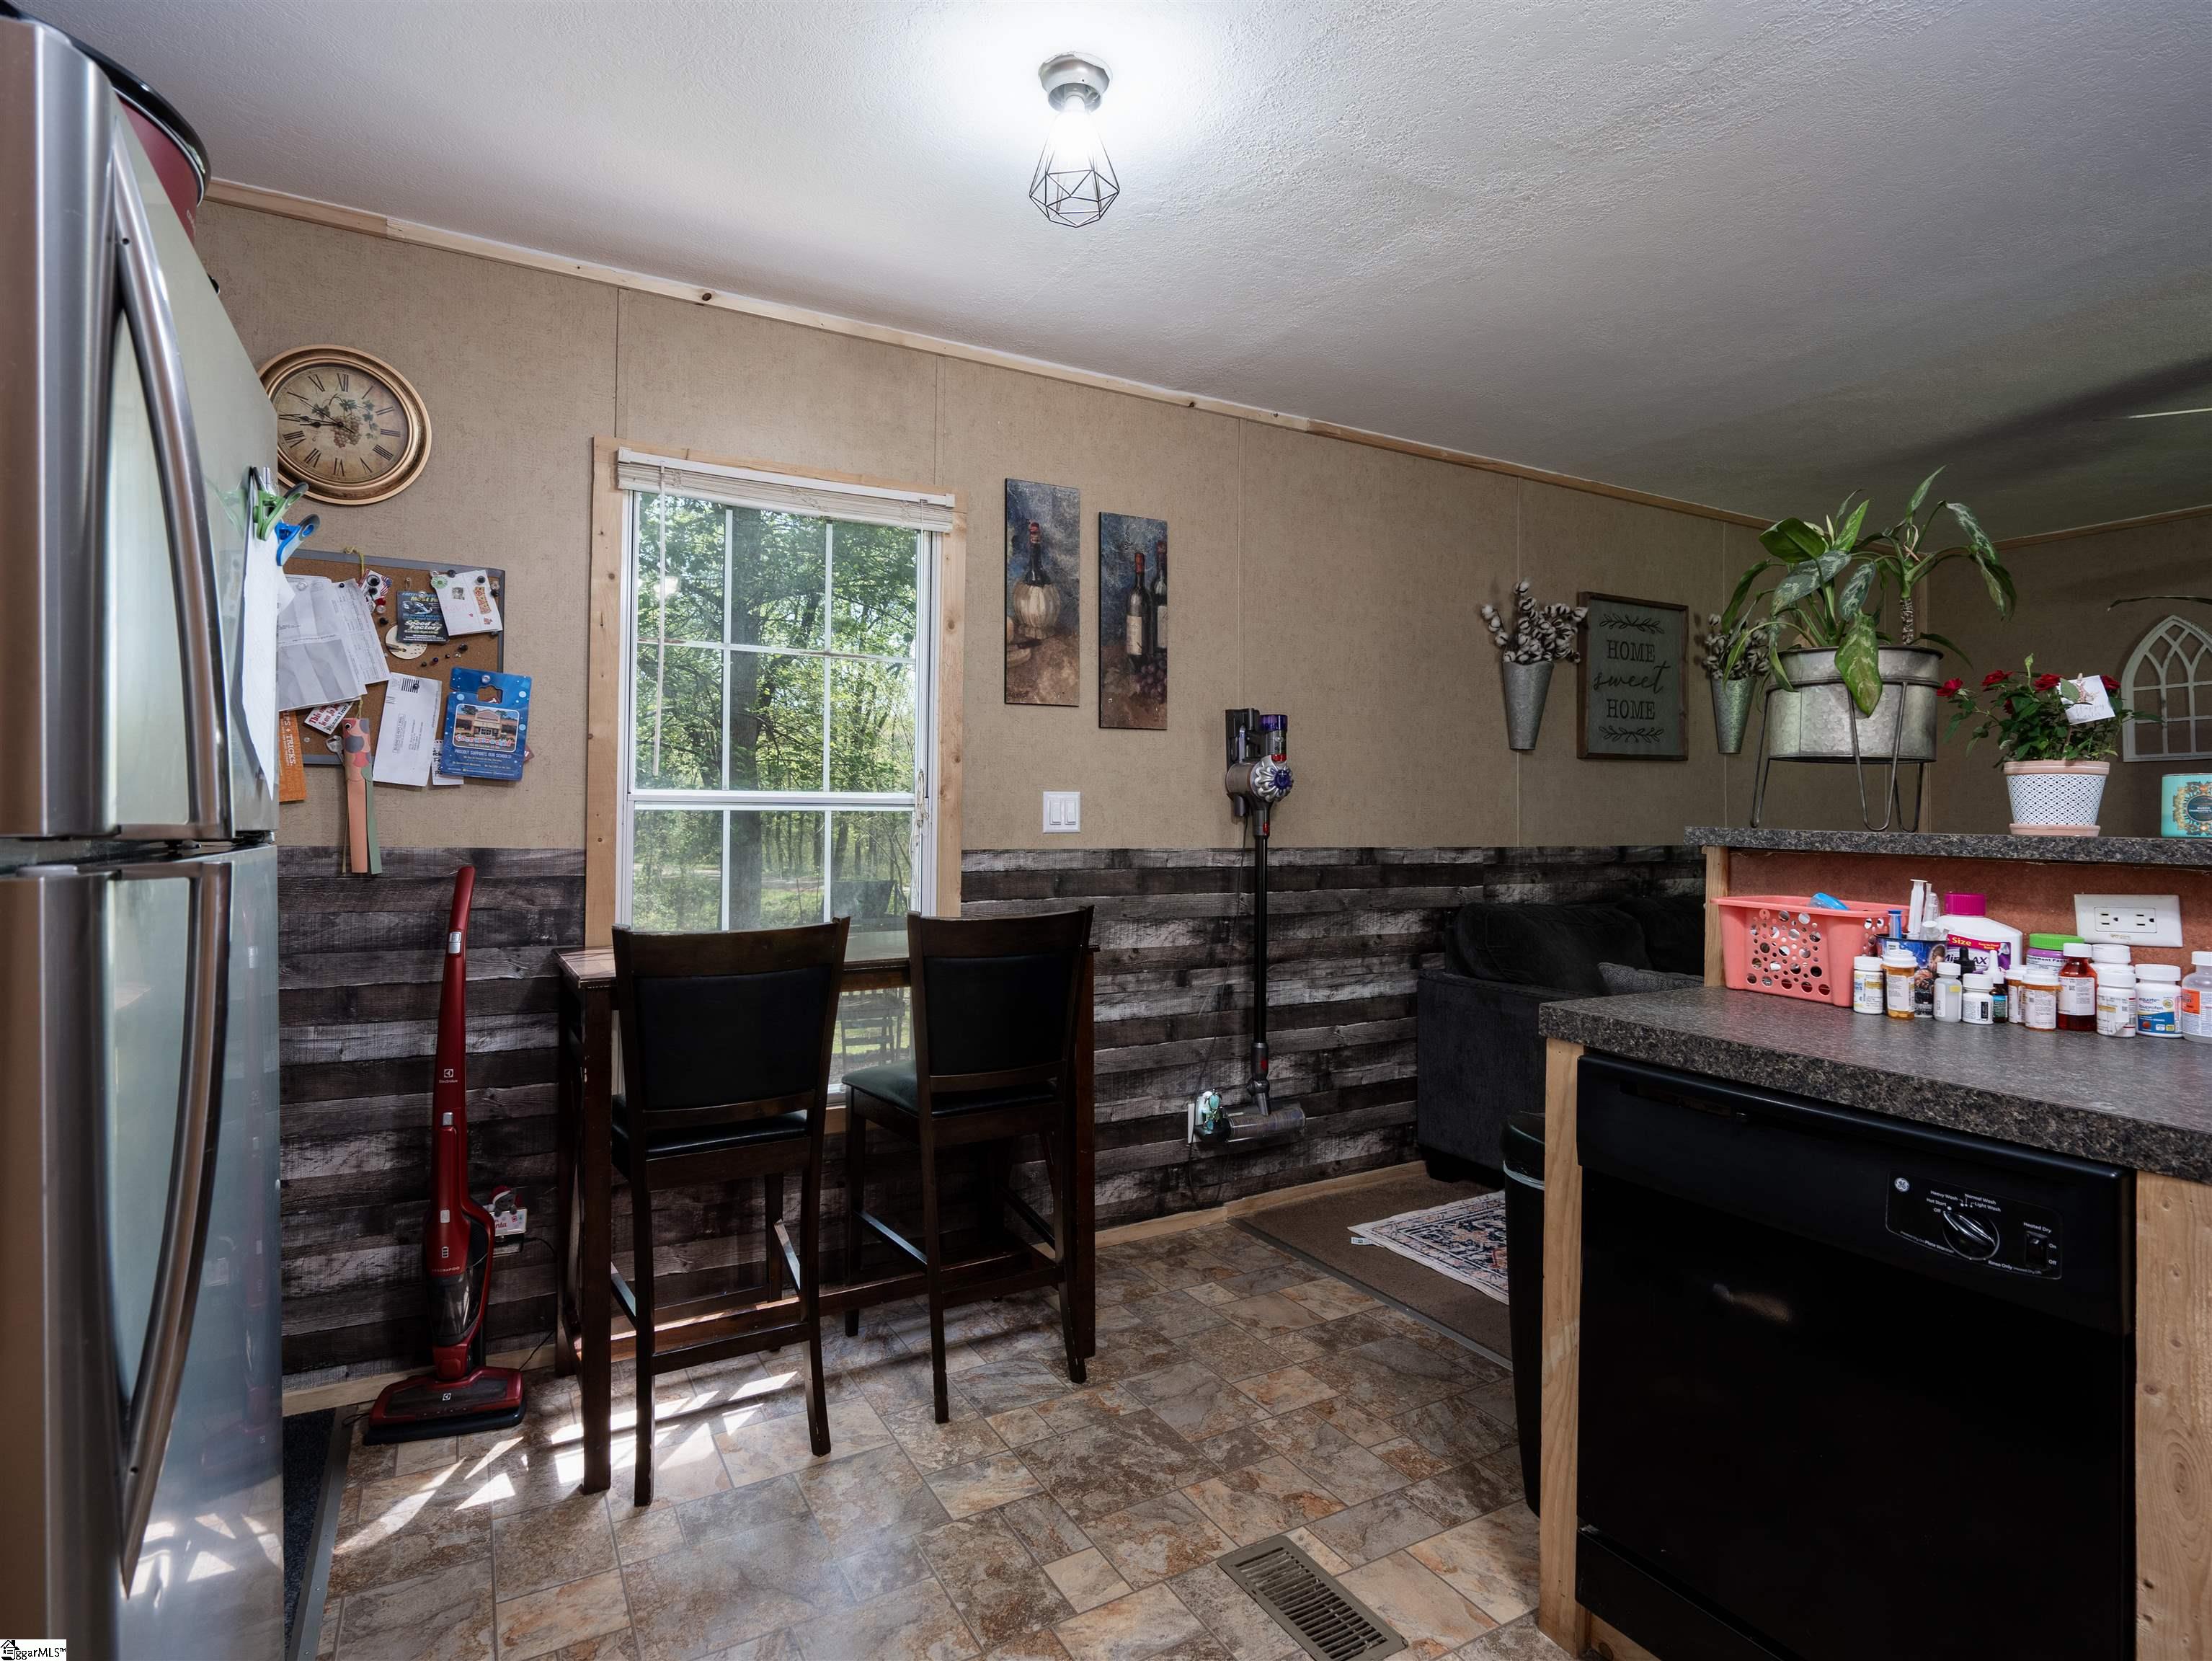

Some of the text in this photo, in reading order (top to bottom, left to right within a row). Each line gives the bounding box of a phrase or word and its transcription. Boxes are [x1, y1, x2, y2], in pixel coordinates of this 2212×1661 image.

[1607, 639, 1656, 663] HOME
[1594, 660, 1671, 694] sweet
[1606, 699, 1656, 720] HOME
[308, 712, 321, 724] This
[1952, 937, 1972, 947] Size
[2023, 1222, 2042, 1231] Heated
